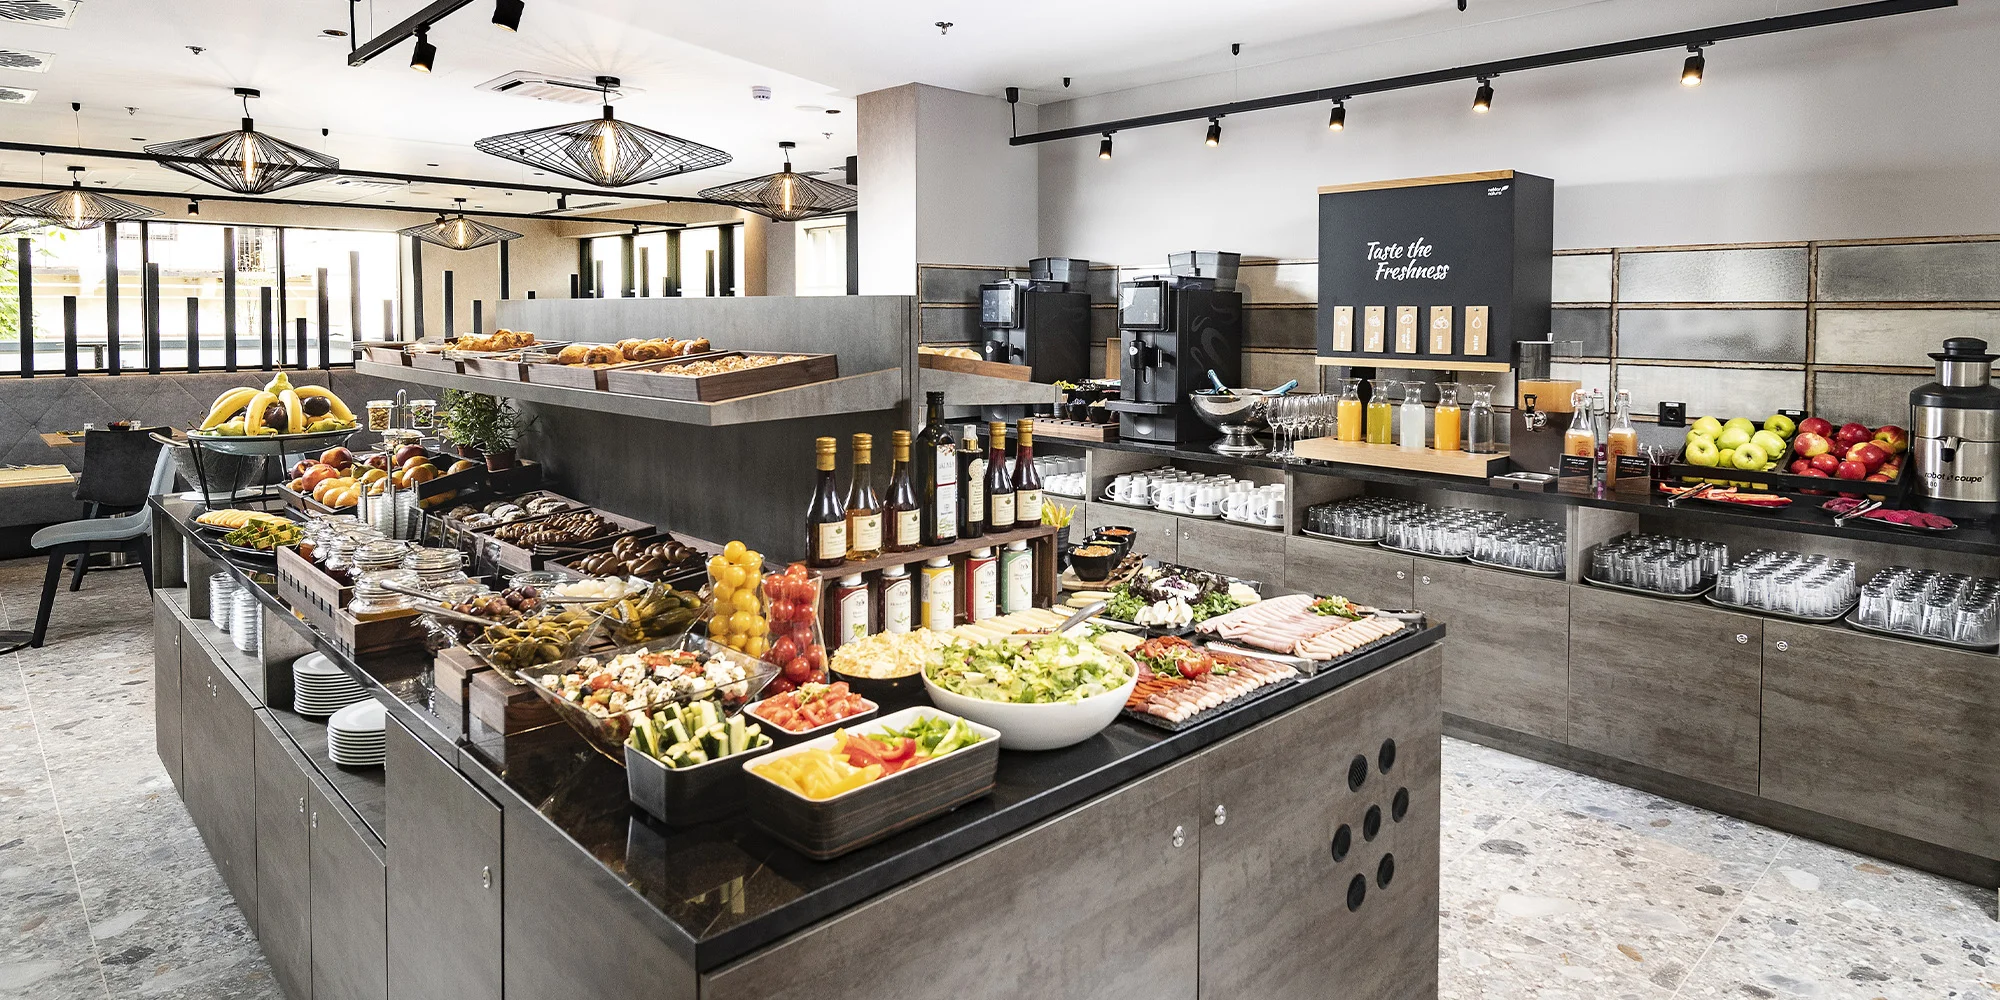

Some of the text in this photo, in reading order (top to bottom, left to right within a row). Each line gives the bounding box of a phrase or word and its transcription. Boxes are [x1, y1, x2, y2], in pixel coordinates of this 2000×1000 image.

[1367, 237, 1432, 261] Taste the
[1375, 259, 1450, 281] Freshness
[1925, 471, 1983, 484] robot coupe
